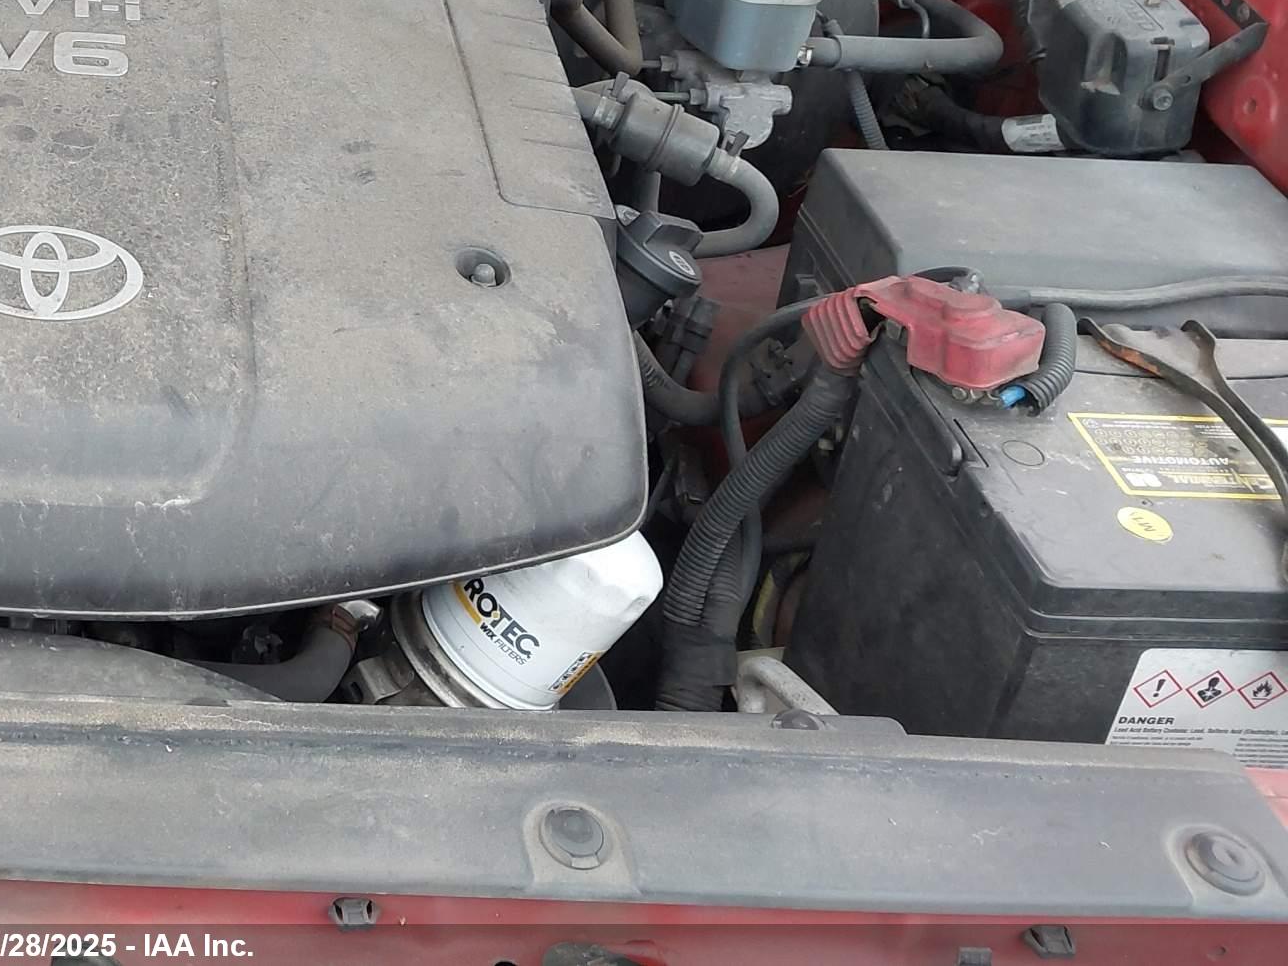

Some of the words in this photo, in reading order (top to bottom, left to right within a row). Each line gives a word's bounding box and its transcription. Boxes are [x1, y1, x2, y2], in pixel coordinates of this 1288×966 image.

[1133, 455, 1230, 466] AUTOMOTIVE
[463, 577, 540, 659] ROTEC
[479, 622, 497, 641] WIX
[494, 638, 528, 666] FILTERS
[1118, 716, 1175, 725] DANGER
